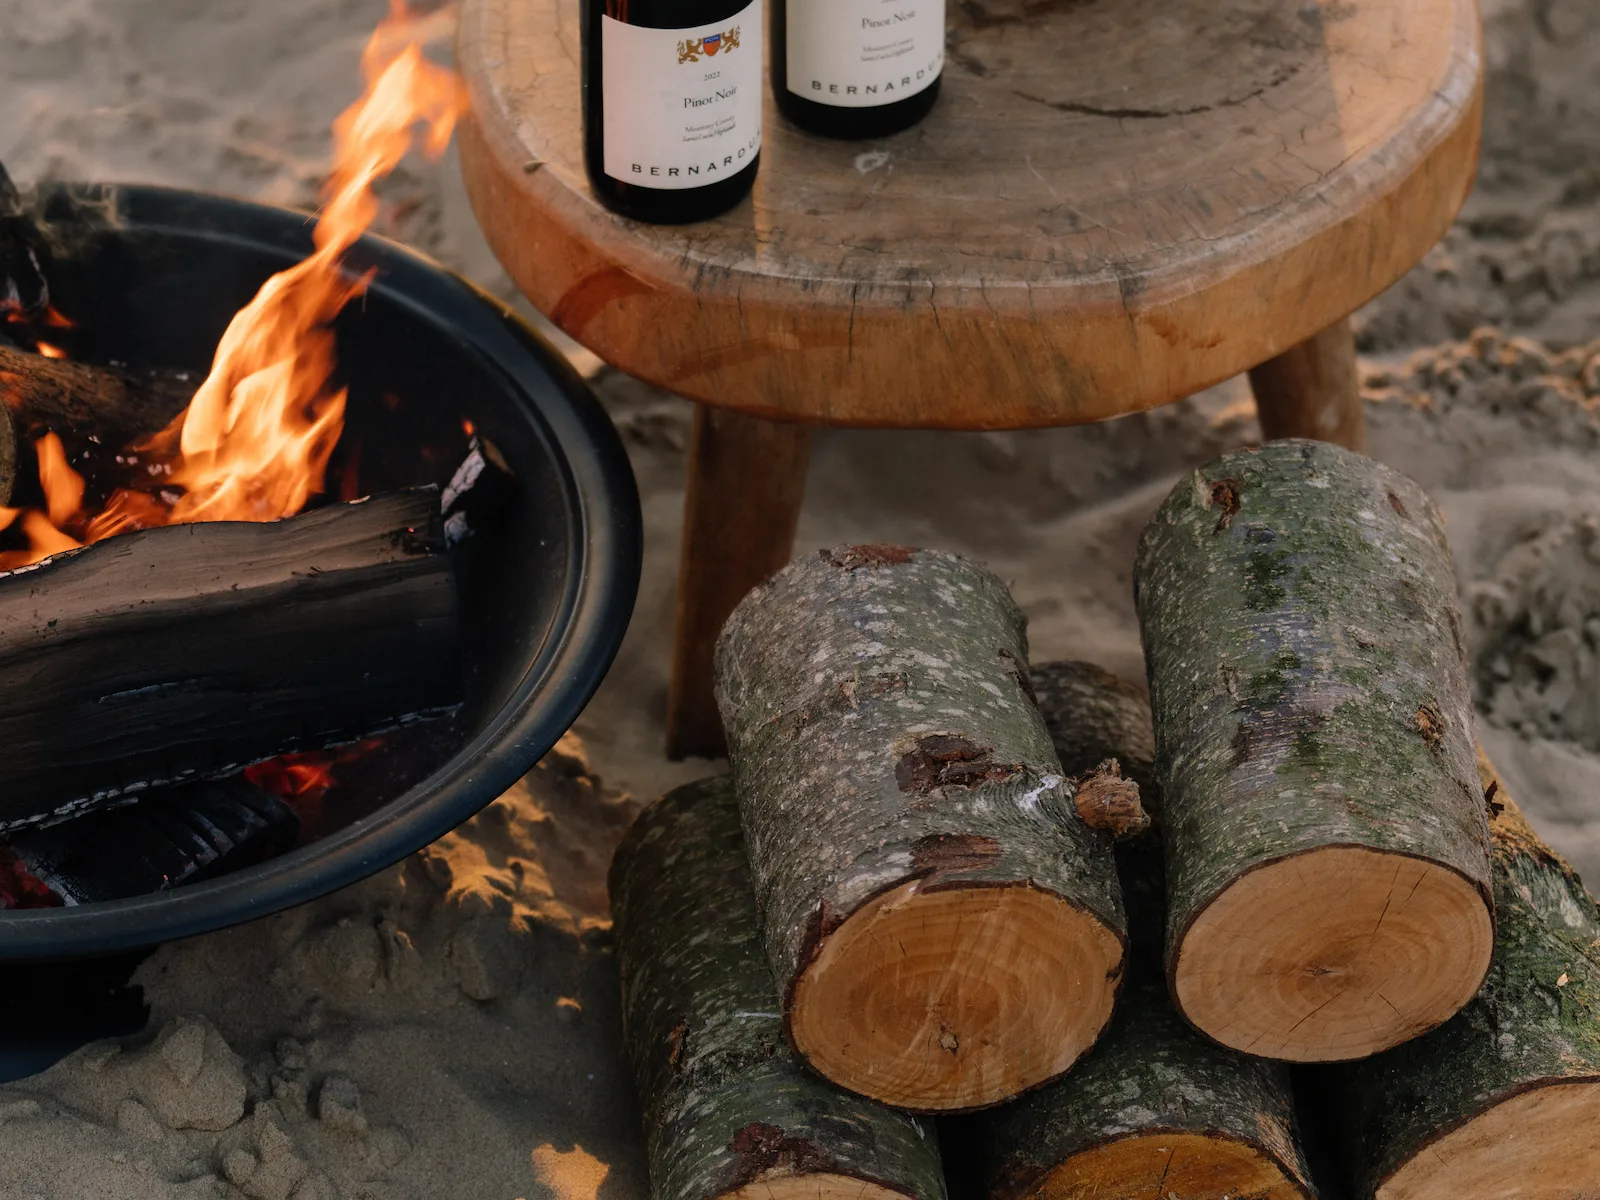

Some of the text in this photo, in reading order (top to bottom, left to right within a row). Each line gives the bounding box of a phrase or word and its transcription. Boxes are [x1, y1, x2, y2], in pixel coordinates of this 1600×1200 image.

[861, 10, 917, 29] Pinot Noir
[703, 70, 720, 81] 2022
[684, 86, 738, 109] Pinot Noir
